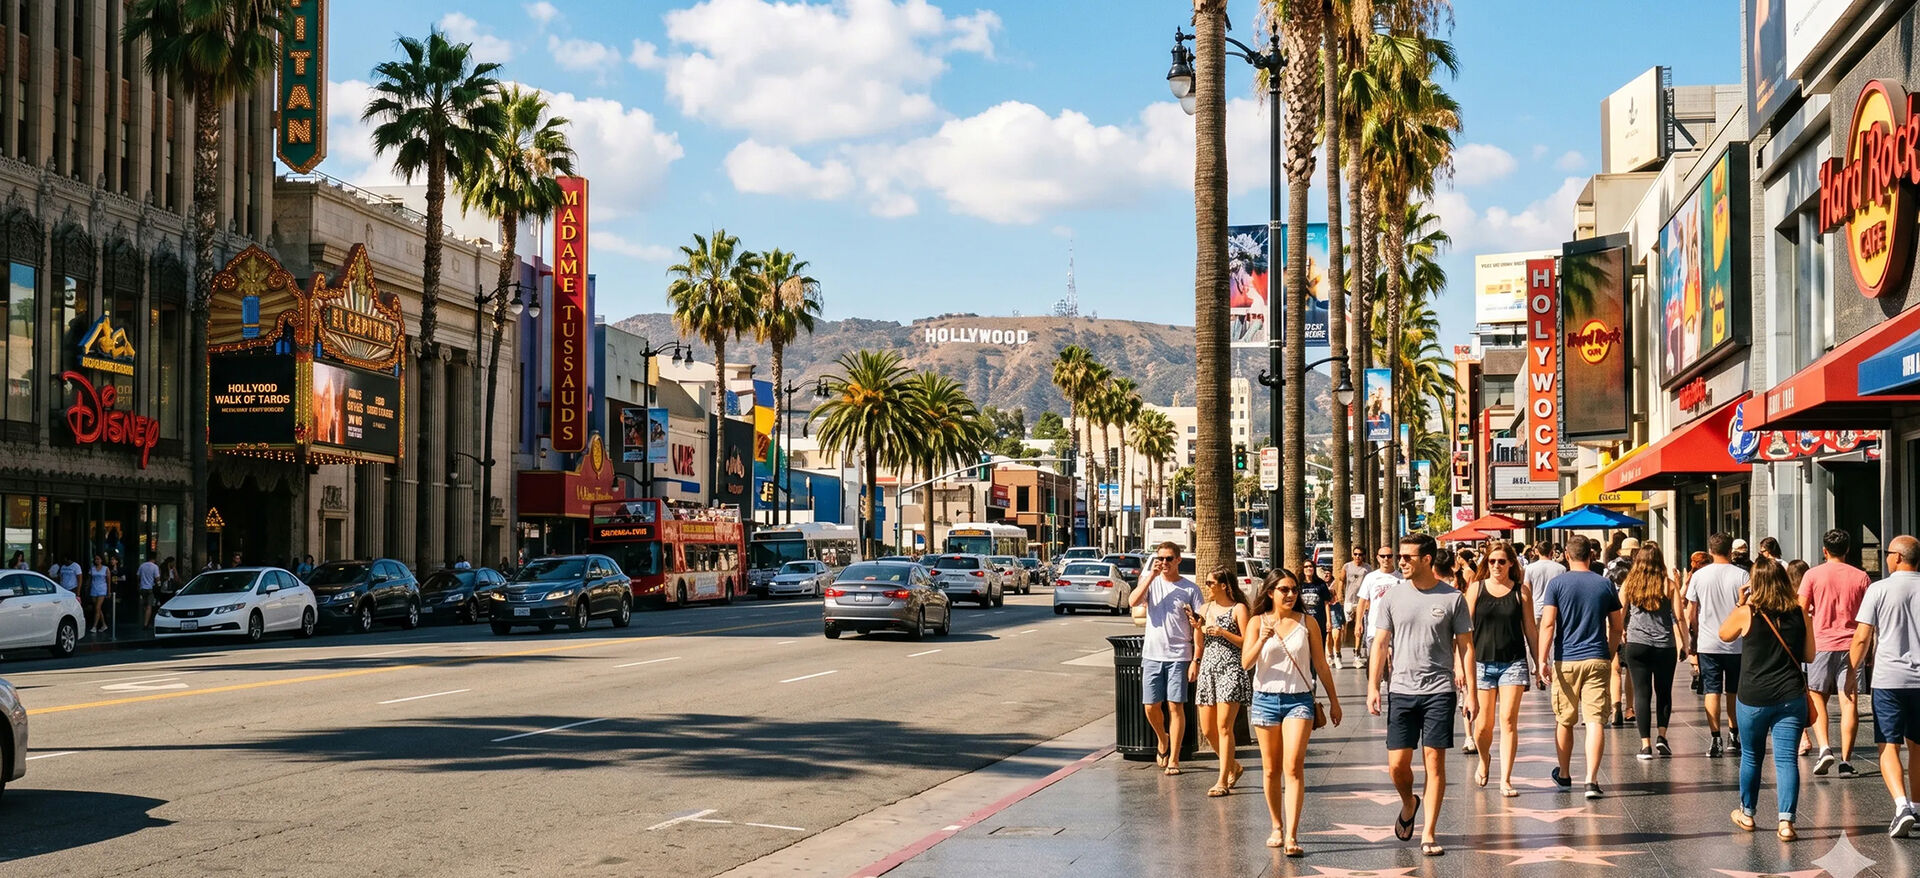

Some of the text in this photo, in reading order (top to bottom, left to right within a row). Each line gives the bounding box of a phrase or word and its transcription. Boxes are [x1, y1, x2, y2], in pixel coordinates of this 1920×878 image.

[286, 0, 313, 143] ITAN
[1819, 92, 1920, 234] Hard Rock
[561, 190, 578, 440] MADAME TUSSAUDS
[925, 328, 1029, 345] HOLLYWOOD
[1531, 268, 1556, 472] HOLYWOCK
[214, 394, 291, 404] WALK OF TAROS
[228, 383, 278, 393] HOLLYOOD
